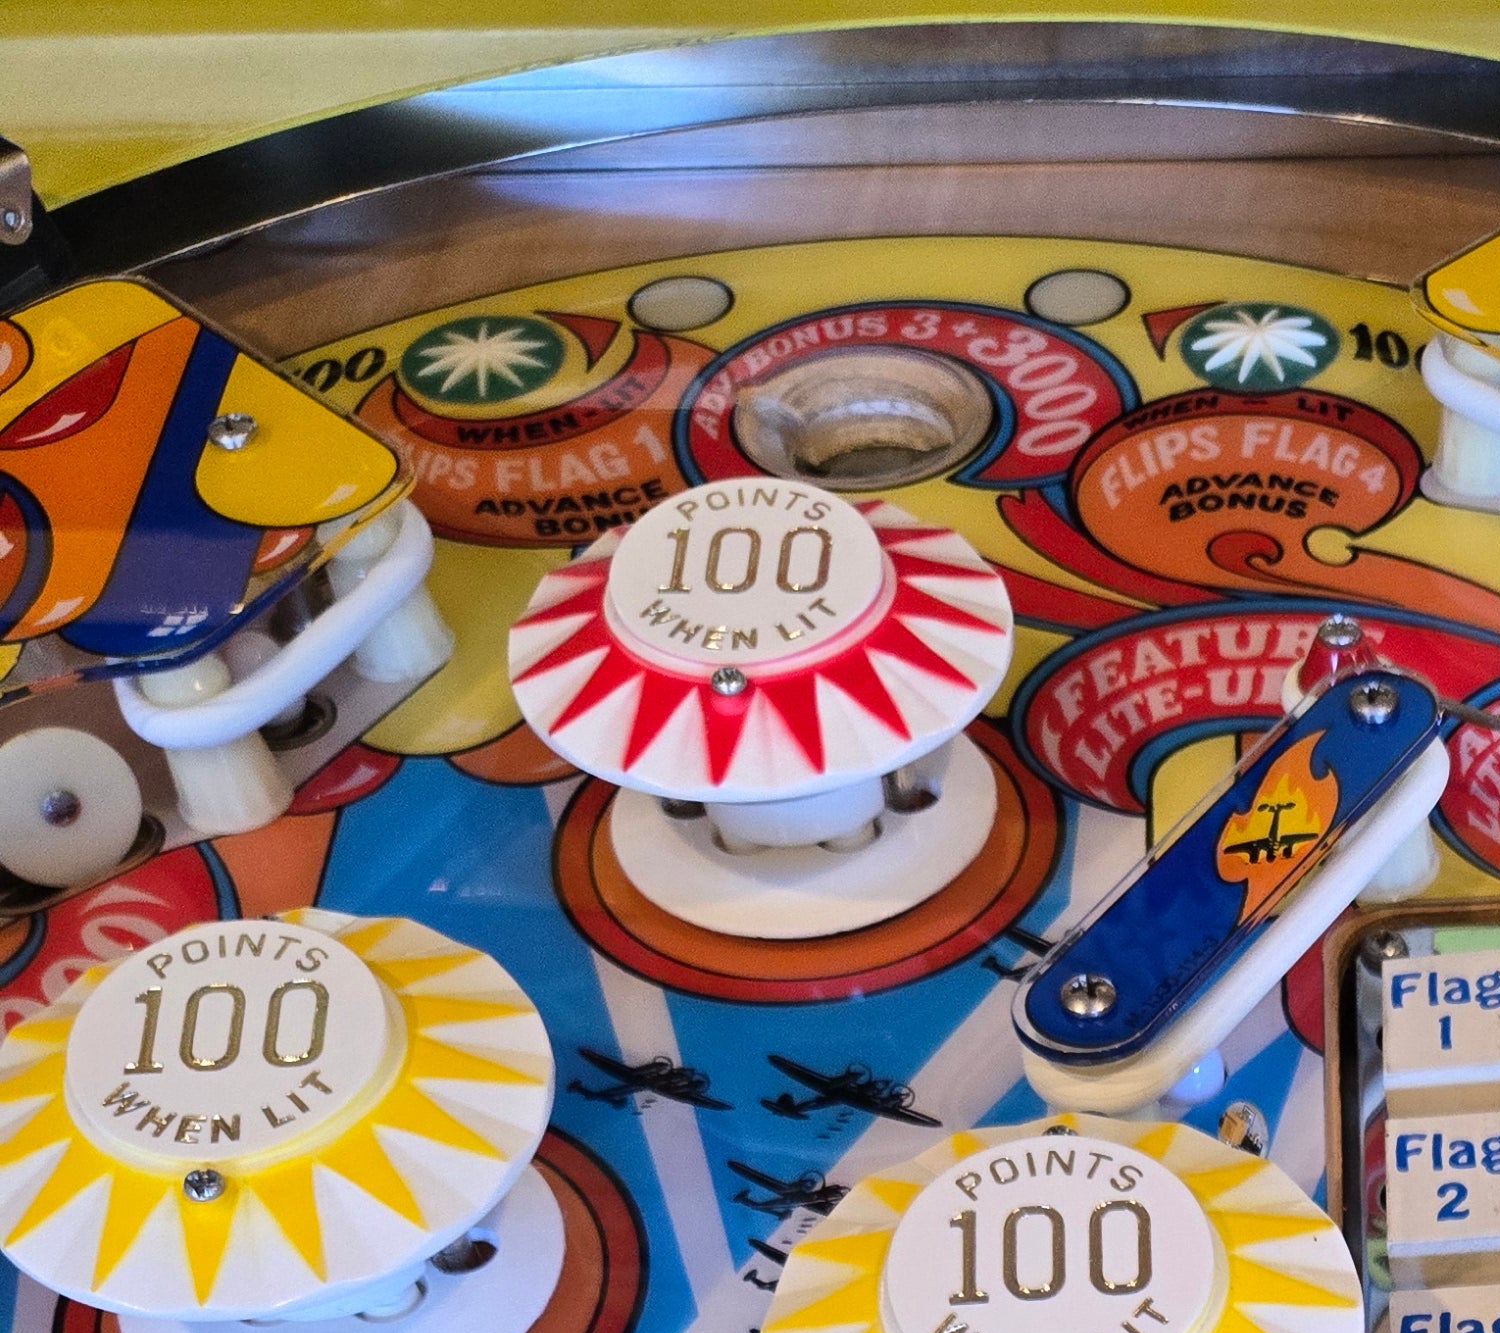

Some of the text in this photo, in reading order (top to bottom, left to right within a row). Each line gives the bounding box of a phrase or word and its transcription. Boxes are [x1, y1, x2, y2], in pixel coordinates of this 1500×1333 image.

[303, 346, 387, 393] 00
[1350, 322, 1428, 374] 10
[693, 367, 734, 441] ADV
[742, 314, 887, 376] BONUS
[902, 312, 940, 341] 3
[967, 328, 1097, 456] 3000
[457, 412, 577, 446] WHEN
[1122, 396, 1219, 433] WHEN
[1297, 397, 1355, 421] LIT
[403, 424, 669, 493] IPS FLAG 1
[1100, 420, 1387, 510] FLIPS FLAG 4
[474, 478, 670, 516] ADVANCE
[677, 487, 832, 523] POINTS
[1159, 473, 1341, 507] ADVANCE
[1168, 492, 1308, 523] BONUS
[657, 526, 833, 594] 100
[639, 597, 837, 651] WHEN LIT
[1054, 622, 1384, 727] FEATUR
[147, 932, 329, 979] POINTS
[123, 976, 330, 1075] 100
[1438, 1015, 1454, 1051] 1
[102, 1069, 335, 1145] WHEN LIT
[955, 1150, 1144, 1202] POINTS
[1436, 1181, 1470, 1222] 2
[948, 1199, 1153, 1307] 100
